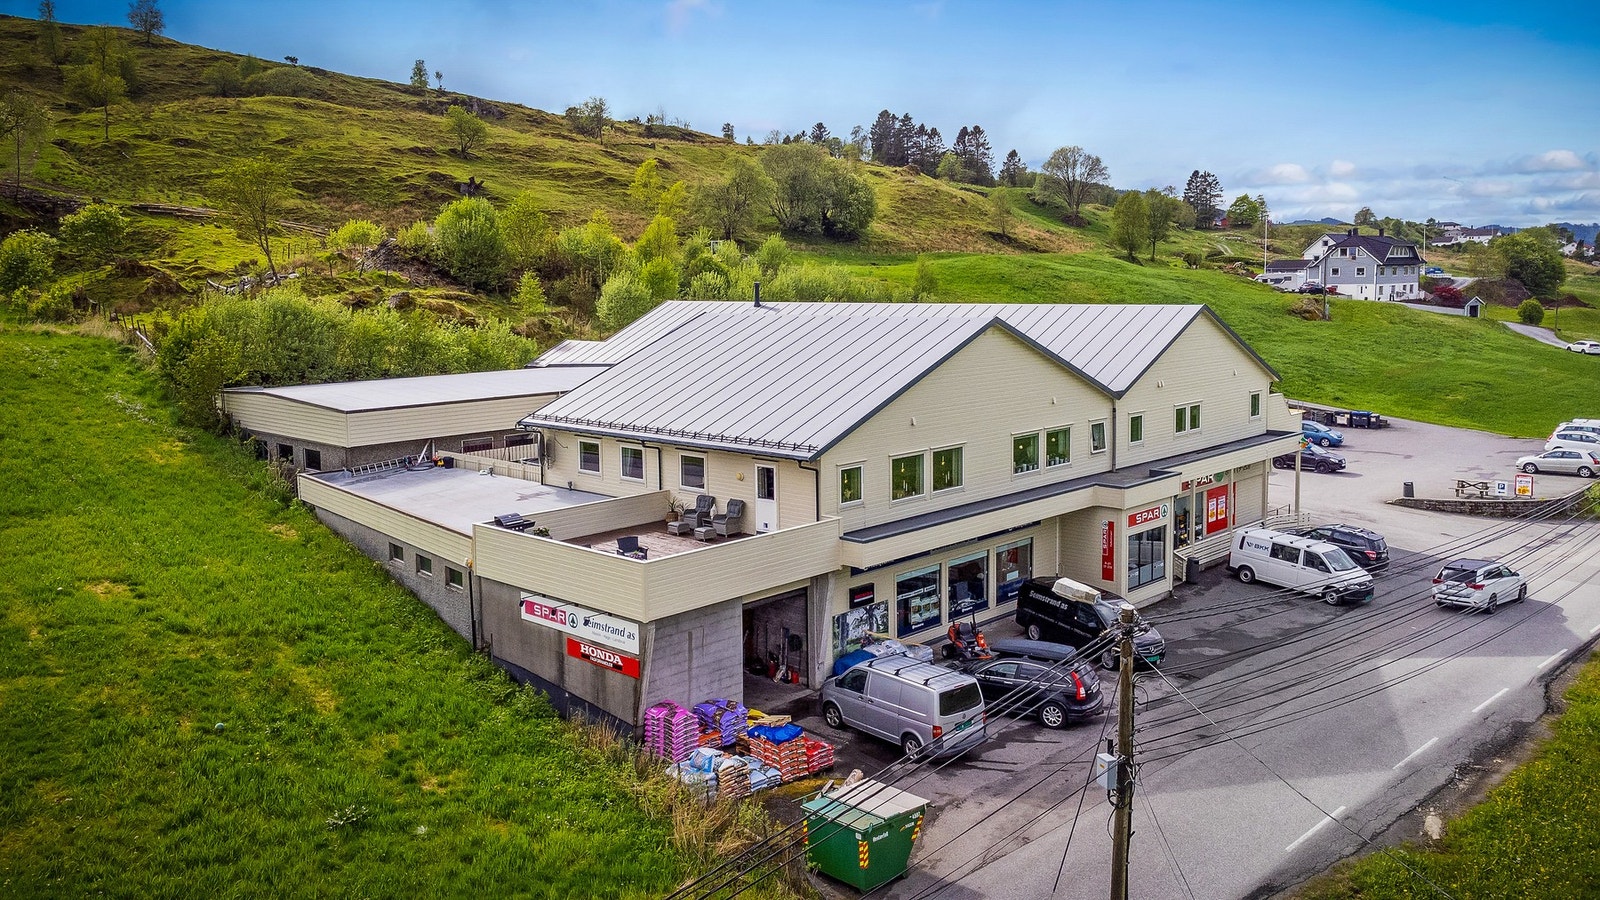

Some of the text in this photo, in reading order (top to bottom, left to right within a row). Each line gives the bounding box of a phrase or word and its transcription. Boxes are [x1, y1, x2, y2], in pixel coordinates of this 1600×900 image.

[1135, 509, 1160, 523] SPAR
[1254, 543, 1270, 552] BKK
[583, 616, 626, 638] eimstrand
[626, 631, 636, 641] as
[579, 643, 624, 666] HONDA
